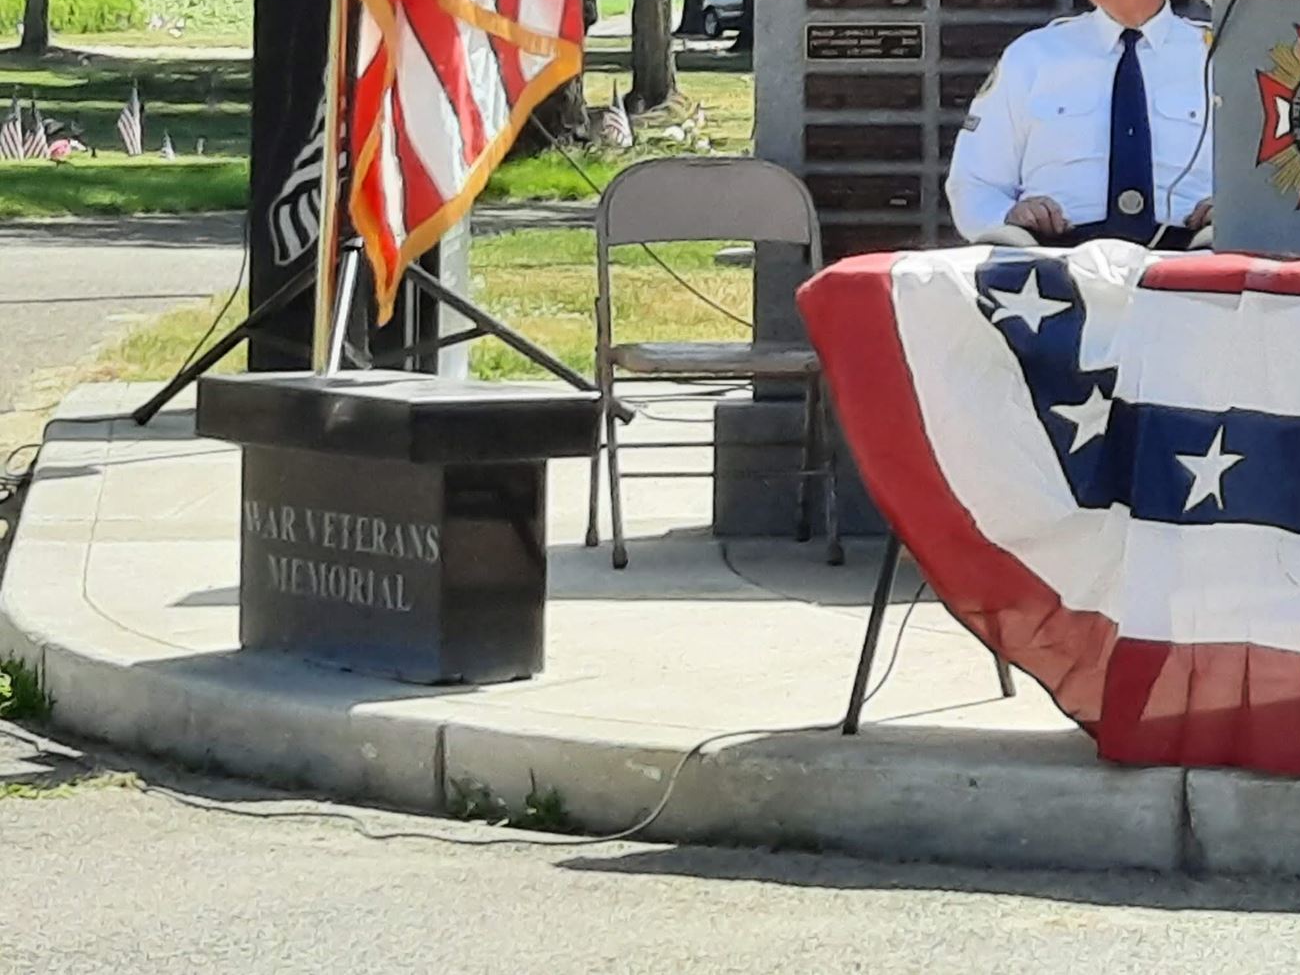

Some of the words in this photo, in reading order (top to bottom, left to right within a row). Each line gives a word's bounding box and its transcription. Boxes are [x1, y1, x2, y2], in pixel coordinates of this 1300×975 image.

[245, 501, 295, 541] WAR
[305, 508, 441, 562] VETERANS
[268, 555, 412, 611] MEMORIAL
